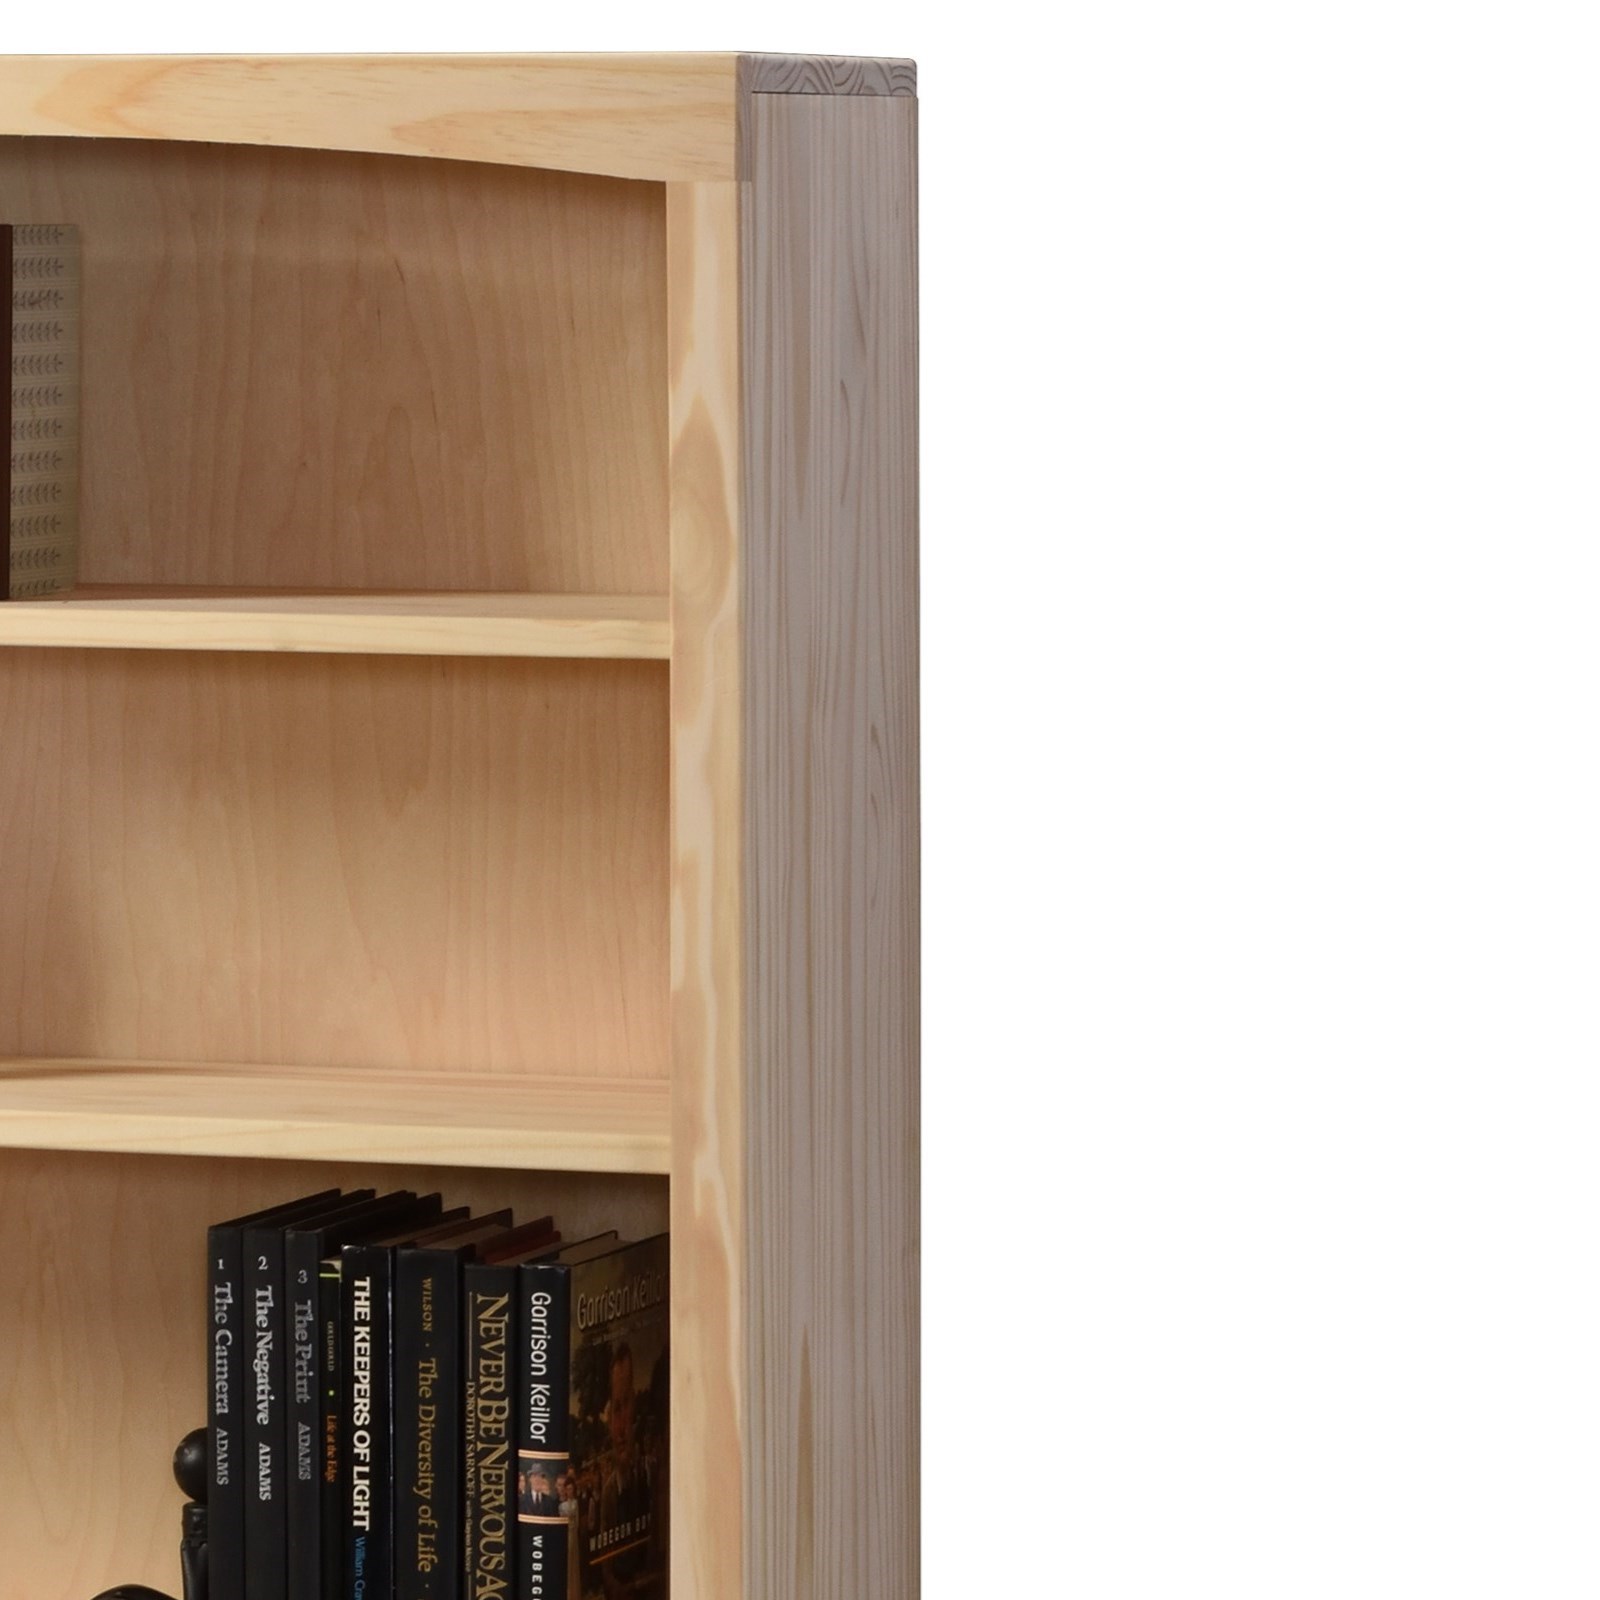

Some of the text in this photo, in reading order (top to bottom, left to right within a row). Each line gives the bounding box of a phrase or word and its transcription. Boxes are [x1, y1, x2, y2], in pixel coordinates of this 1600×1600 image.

[217, 1259, 224, 1270] 1
[258, 1256, 268, 1270] 2
[298, 1270, 308, 1284] 3
[422, 1278, 432, 1332] WILSON
[576, 1285, 630, 1330] Garrison
[215, 1282, 234, 1486] The Camera ADAMS
[252, 1285, 275, 1501] The Negative ADAMS
[294, 1300, 314, 1480] The Print ADAMS
[477, 1292, 509, 1394] NEVER
[530, 1291, 552, 1444] Garrison Keillor
[353, 1277, 370, 1531] THE KEEPERS OF LIGHT
[466, 1381, 475, 1498] DOROTHY SARNOFF
[477, 1397, 509, 1438] BE
[413, 1358, 438, 1573] The Diversity of Life
[477, 1441, 509, 1570] NERVOUS
[354, 1536, 366, 1577] William
